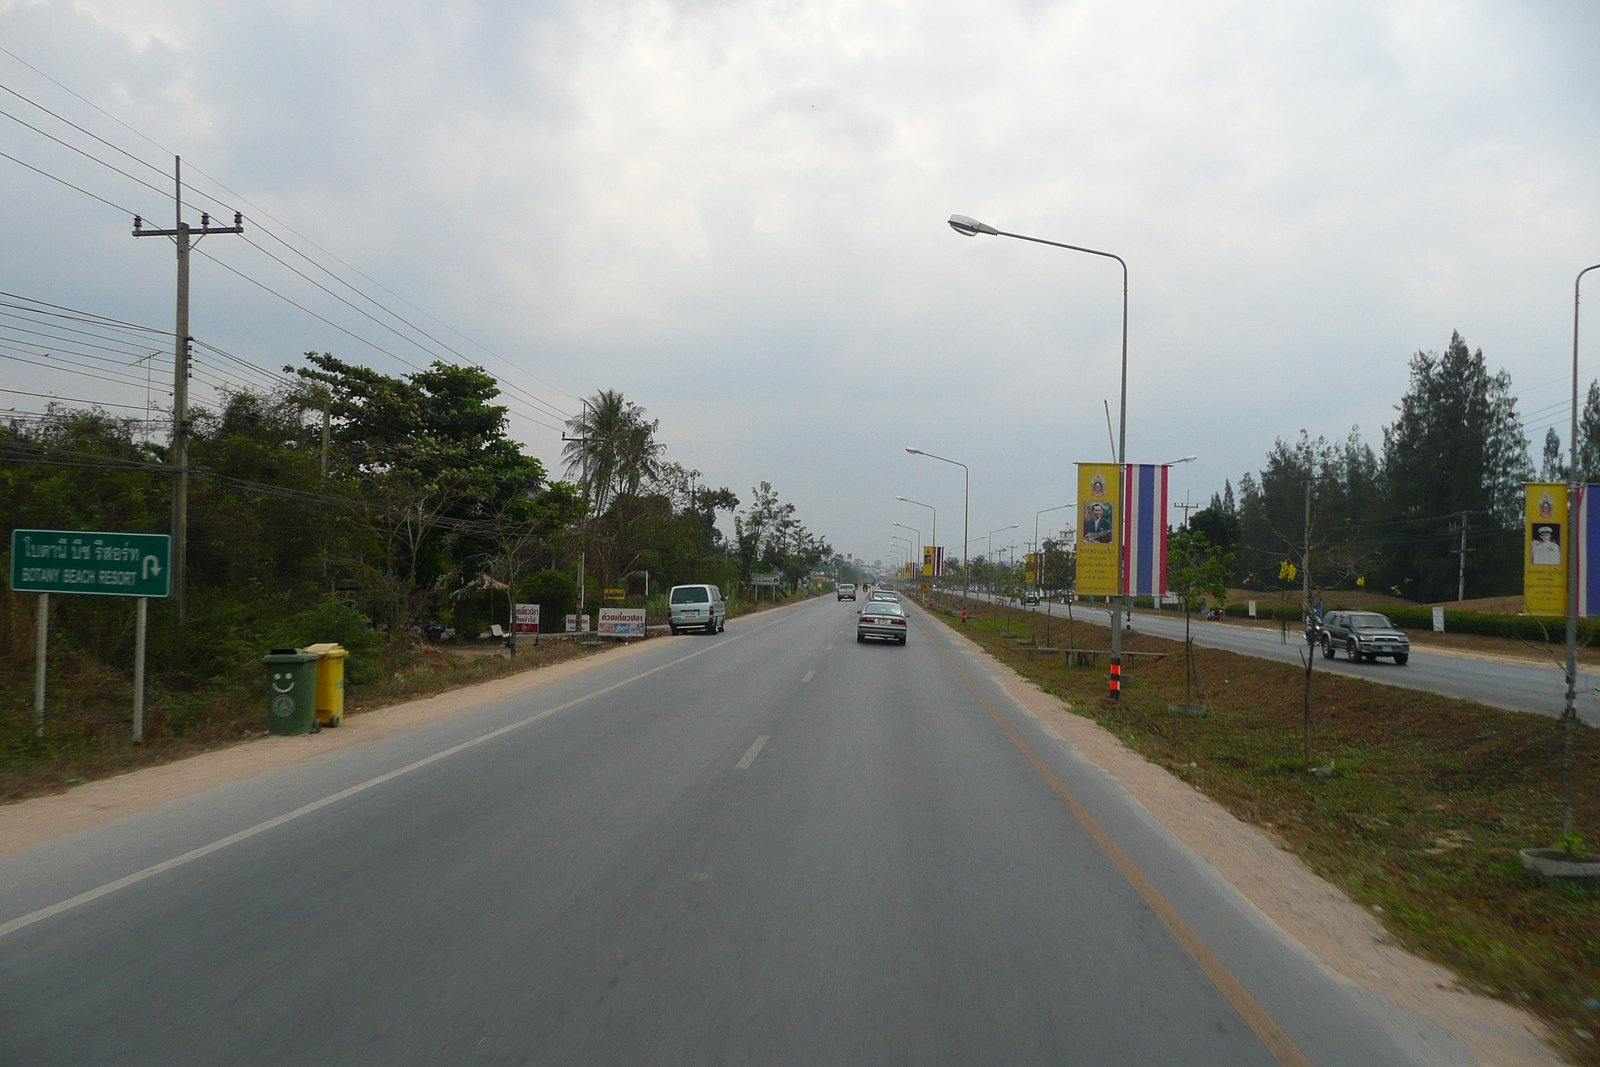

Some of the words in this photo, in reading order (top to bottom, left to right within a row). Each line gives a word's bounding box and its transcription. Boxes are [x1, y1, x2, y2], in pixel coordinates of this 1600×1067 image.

[22, 568, 60, 582] BOTANY
[62, 569, 96, 584] BEACH
[98, 570, 137, 585] RESORT
